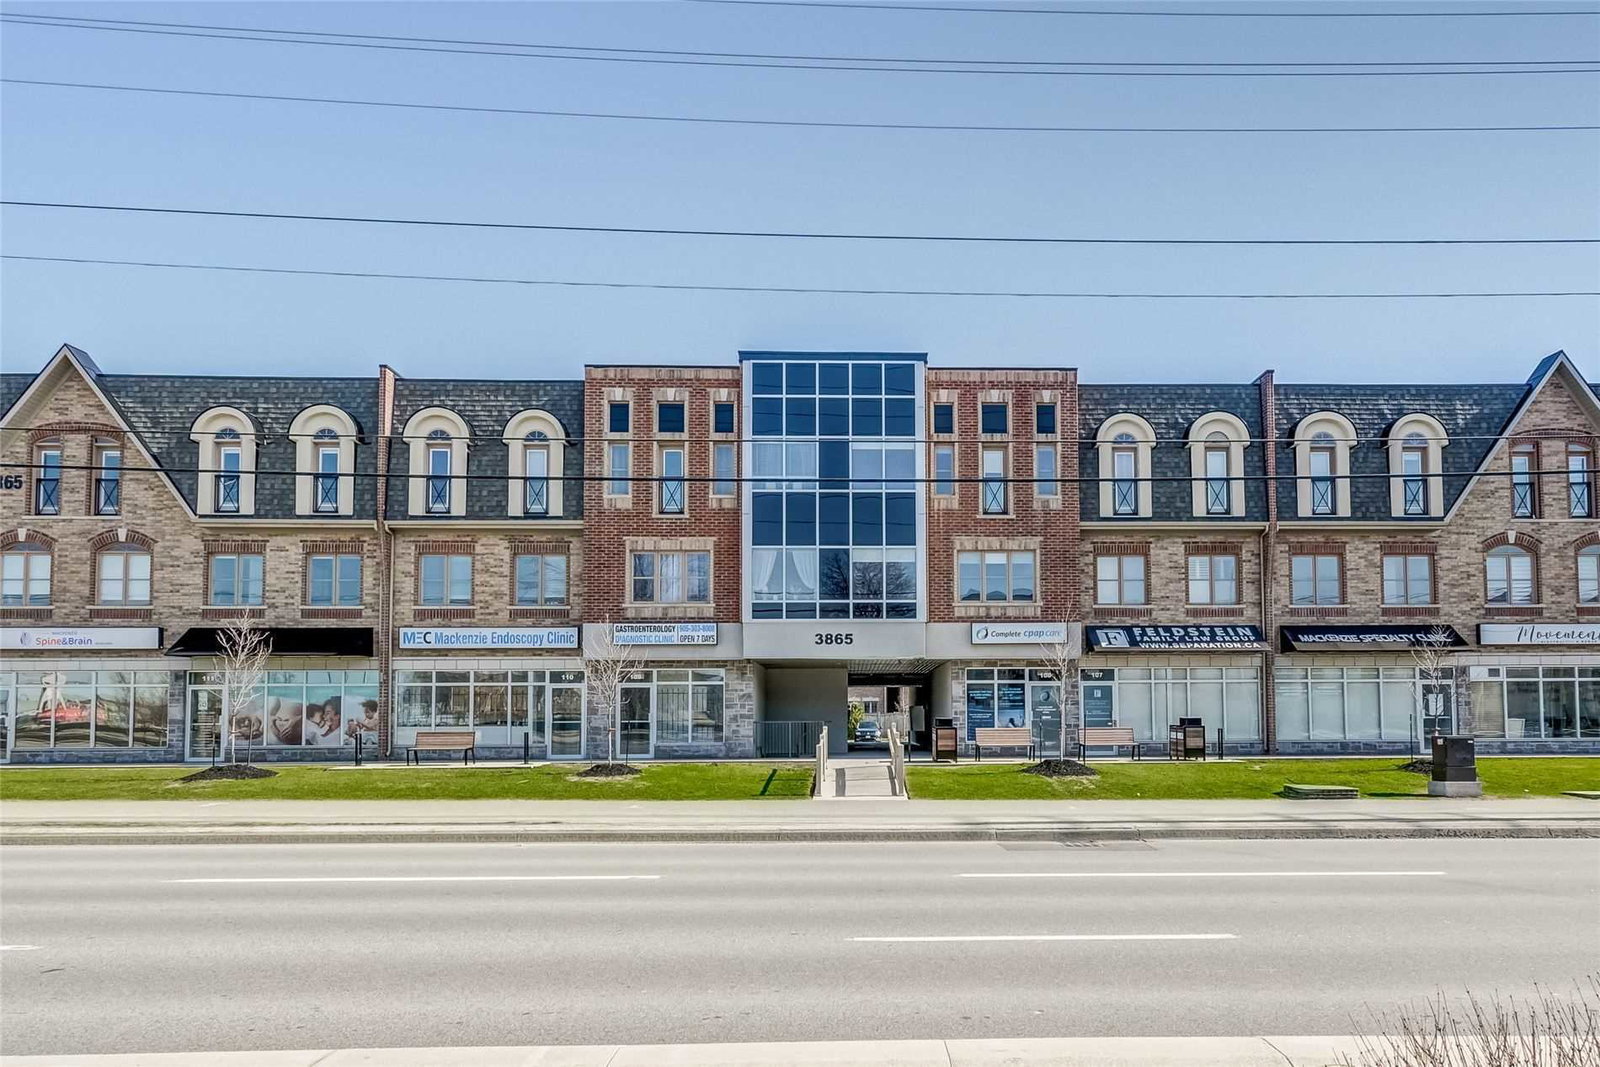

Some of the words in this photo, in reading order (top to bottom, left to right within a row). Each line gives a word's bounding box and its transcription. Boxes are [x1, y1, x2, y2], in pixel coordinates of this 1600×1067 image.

[615, 625, 676, 633] GASTROENTEROLOGY
[991, 630, 1021, 638] Complete
[1023, 629, 1045, 638] cpap
[1132, 627, 1253, 636] FELDSTEIN
[1517, 625, 1600, 642] Movemen
[35, 637, 93, 647] Spine&Brain
[403, 631, 432, 644] MEC
[434, 631, 488, 644] Mackenzie
[491, 631, 544, 646] Endoscopy
[547, 631, 575, 644] Clinic
[615, 635, 653, 643] DIAGNOSTIC
[654, 635, 675, 643] CLINIC
[680, 635, 695, 643] OPEN
[696, 635, 700, 643] 7
[701, 635, 715, 643] DAYS
[814, 633, 853, 645] 3865
[1298, 633, 1360, 643] MACKENZIE
[1358, 633, 1415, 642] SPECIALTY
